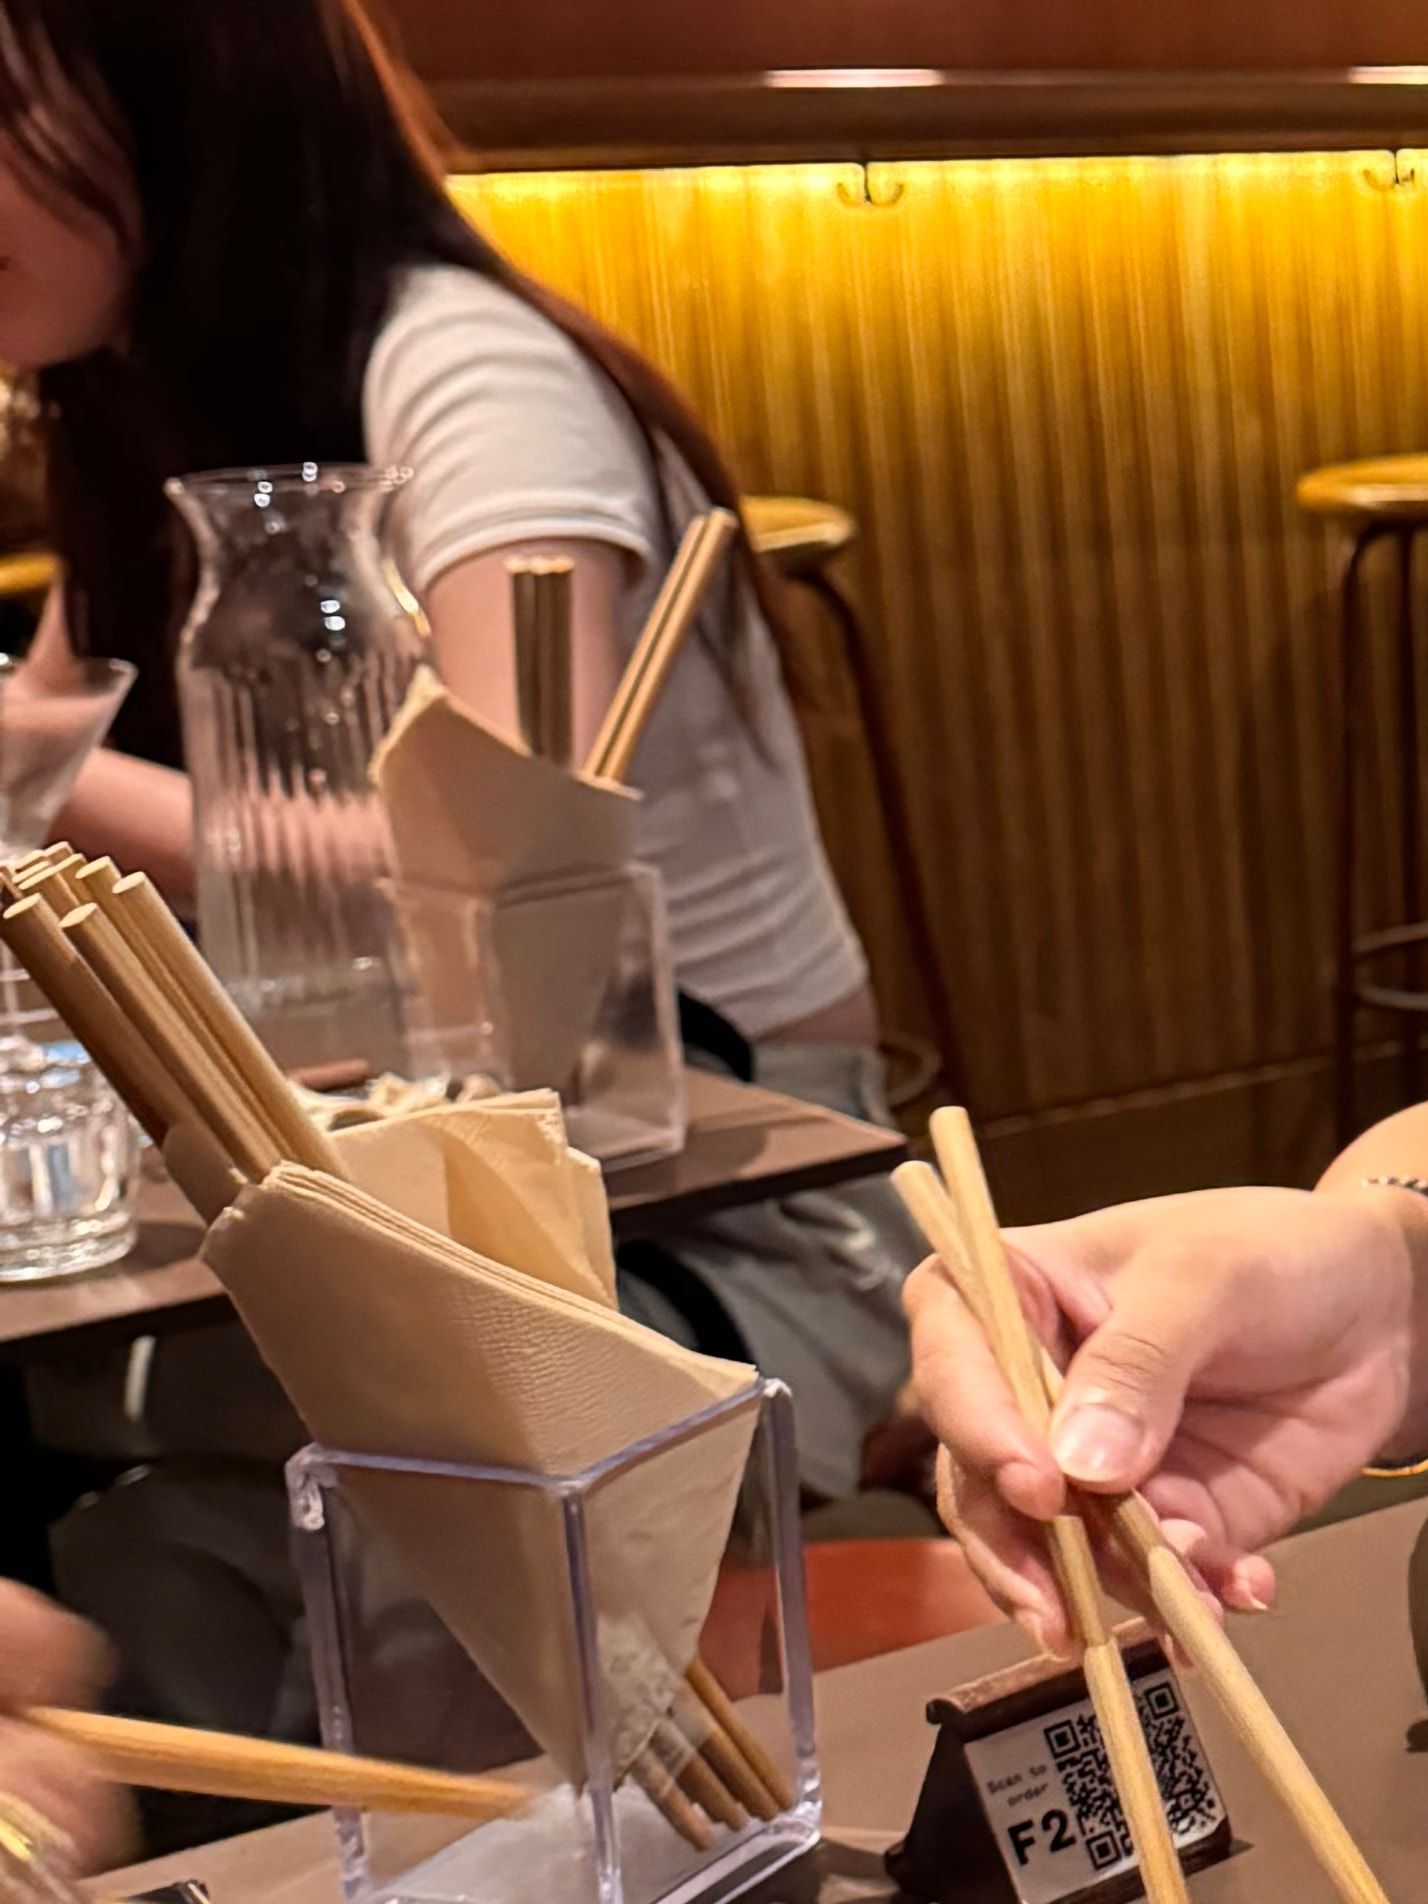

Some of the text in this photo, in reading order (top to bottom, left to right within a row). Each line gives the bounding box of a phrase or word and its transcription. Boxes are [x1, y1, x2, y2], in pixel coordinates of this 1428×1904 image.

[987, 1762, 1048, 1795] Scan to
[1006, 1781, 1050, 1808] order
[1008, 1808, 1076, 1866] F2
